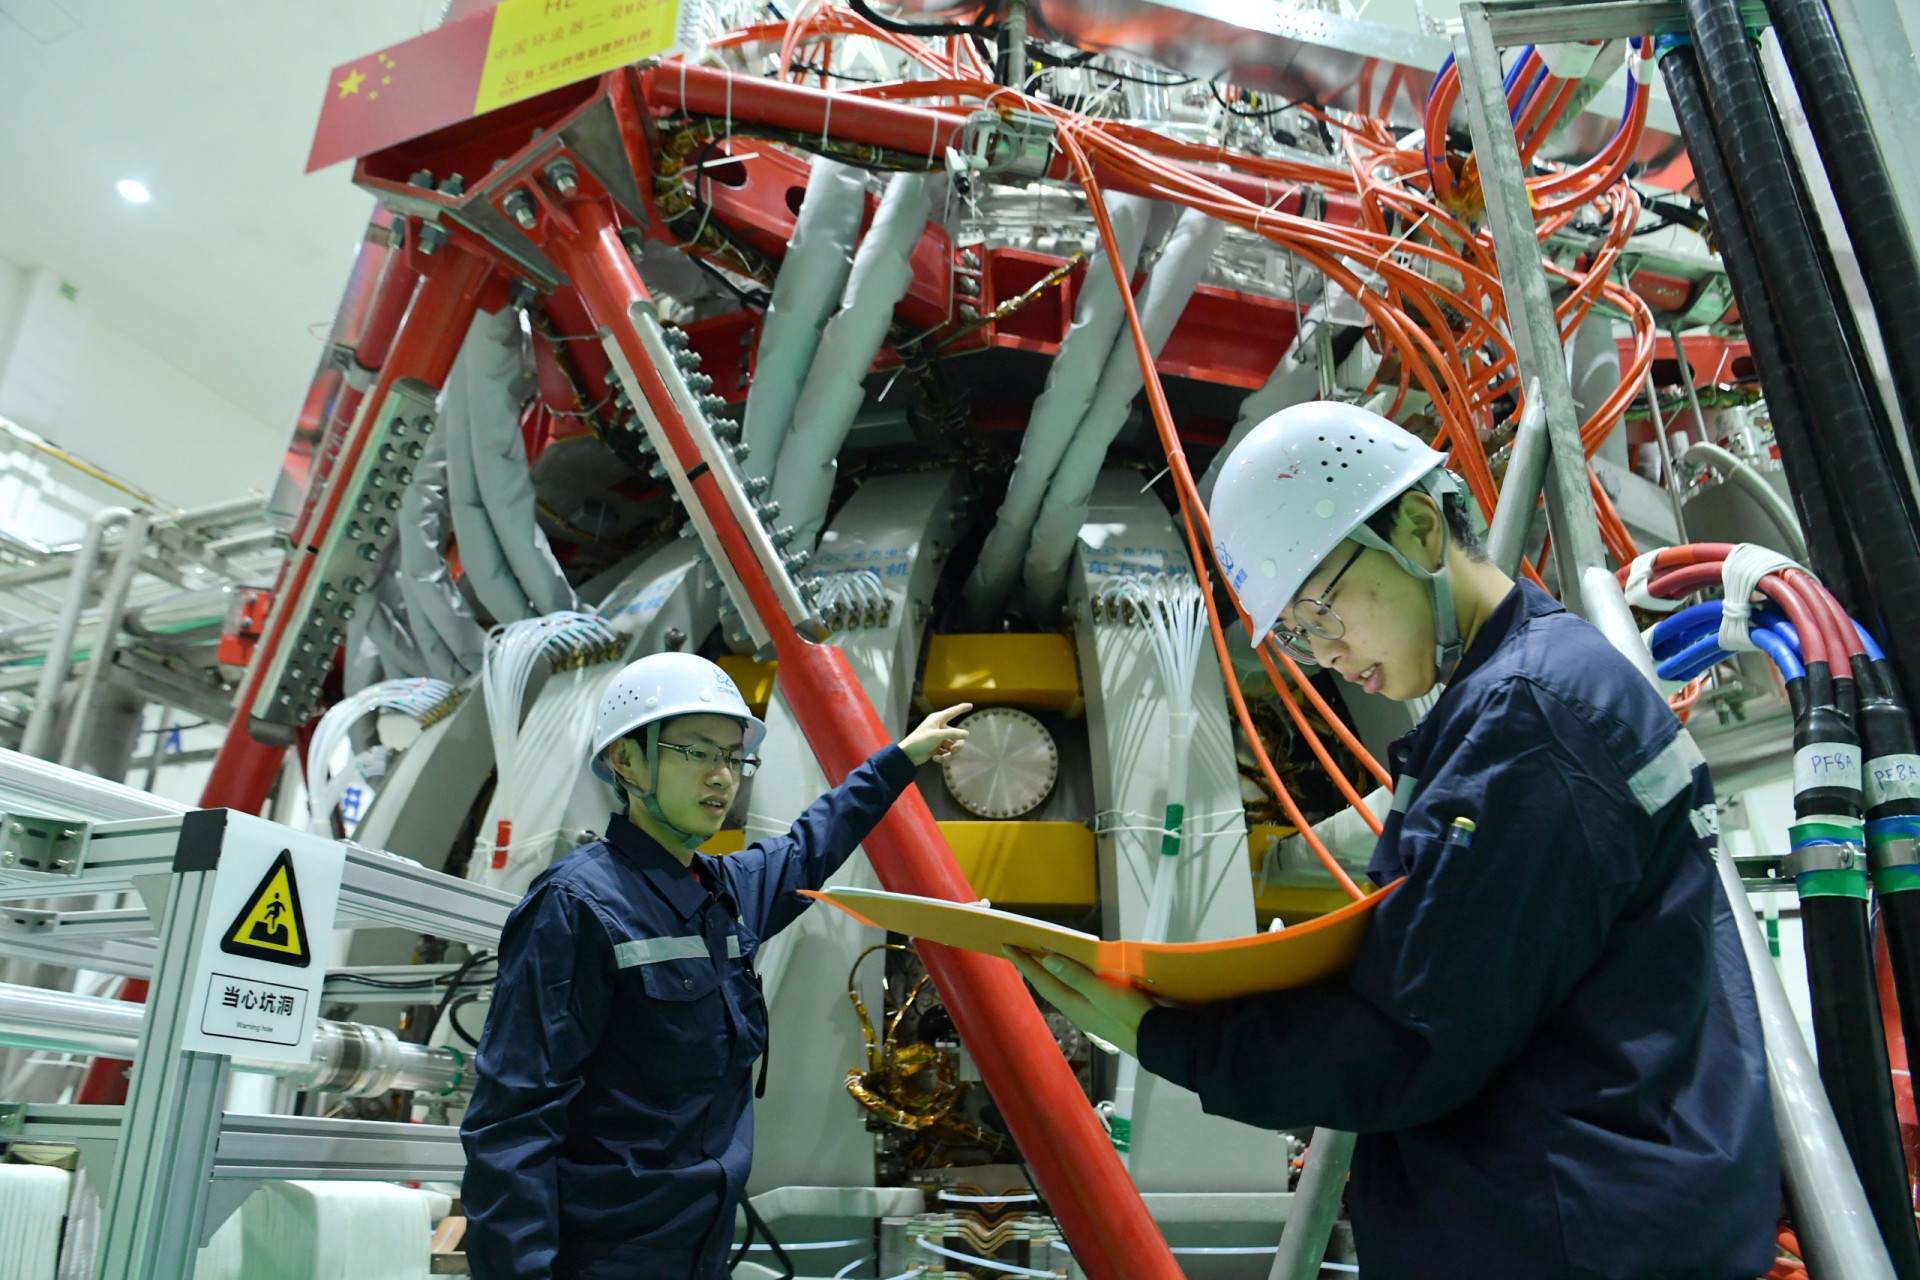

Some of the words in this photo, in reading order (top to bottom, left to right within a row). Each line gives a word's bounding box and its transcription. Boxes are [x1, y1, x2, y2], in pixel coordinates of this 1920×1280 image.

[1811, 752, 1854, 774] PF8A
[222, 986, 294, 1016] 当心坑洞
